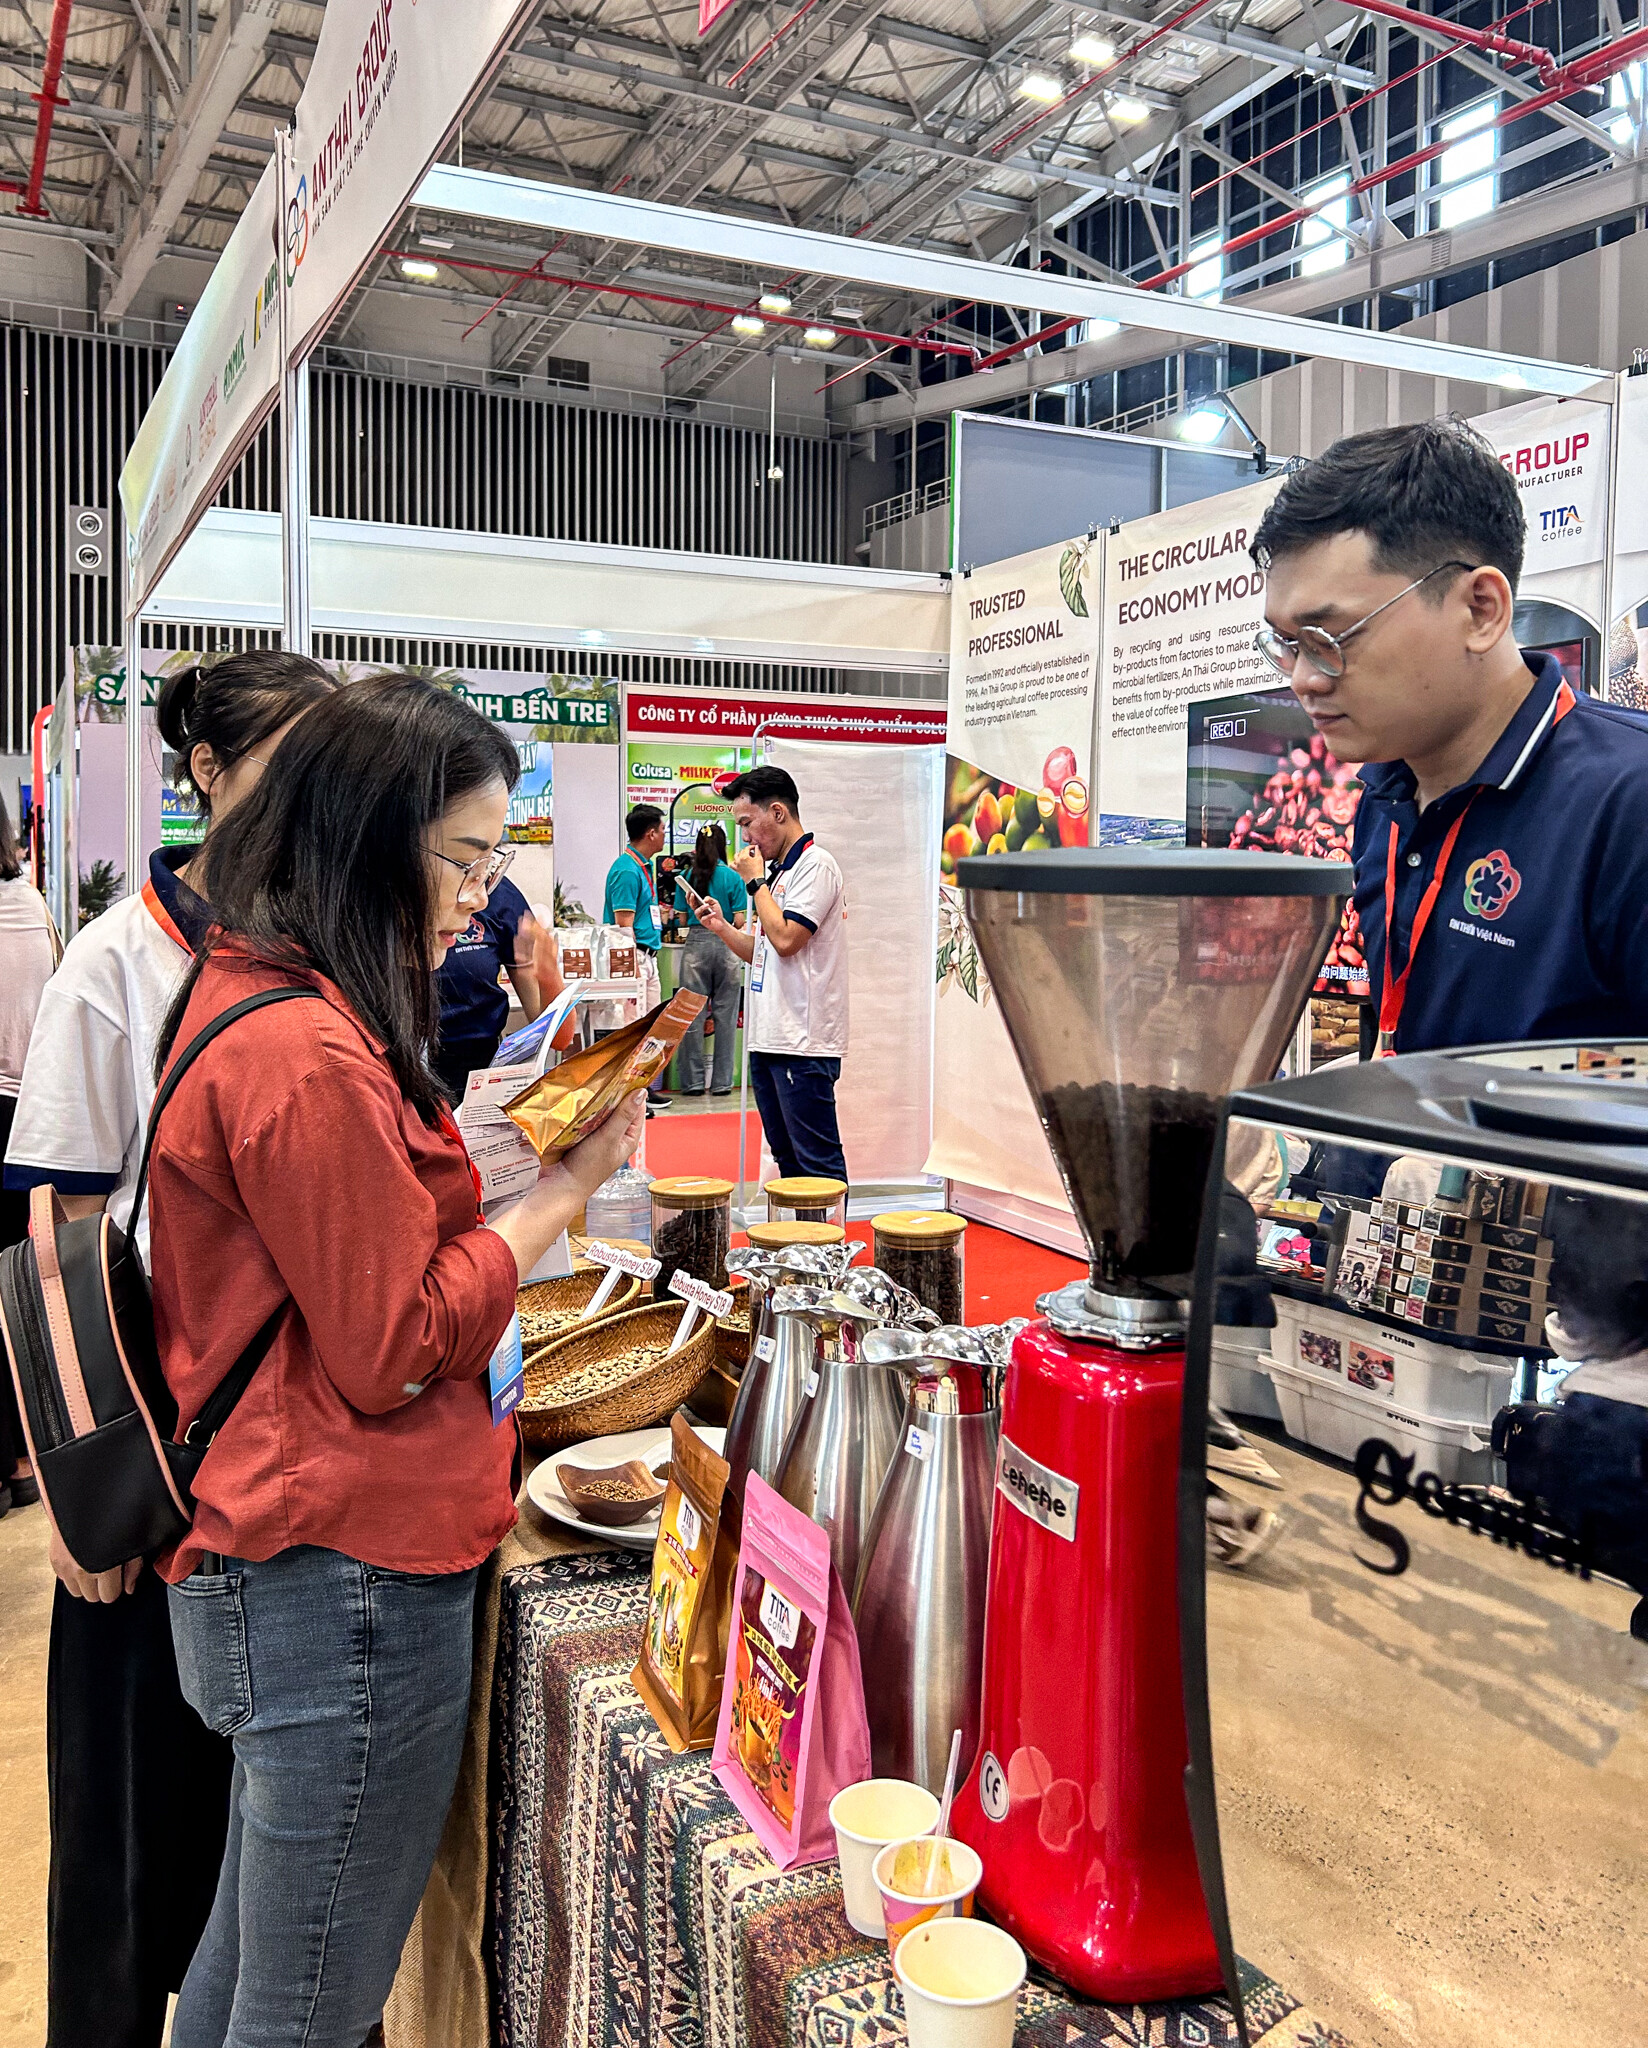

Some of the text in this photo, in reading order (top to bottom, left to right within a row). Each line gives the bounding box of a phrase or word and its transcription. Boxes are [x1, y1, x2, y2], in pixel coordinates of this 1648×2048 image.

[312, 0, 393, 211] ANTHAI GROUP
[1499, 432, 1590, 476] GROUP
[1540, 505, 1585, 531] TITA
[1541, 525, 1583, 542] coffee
[1118, 528, 1248, 581] THE CIRCULAR
[969, 588, 1026, 620] TRUSTED
[1118, 583, 1212, 624] ECONOMY
[968, 619, 1064, 657] PROFESSIONAL
[1113, 620, 1261, 659] By recycling and using resources
[986, 671, 992, 680] in
[991, 667, 1004, 679] 1992
[1004, 666, 1016, 676] and
[1016, 661, 1043, 675] officially
[1043, 653, 1083, 670] established
[1082, 652, 1090, 663] in
[1112, 674, 1146, 690] microbial
[1146, 670, 1181, 685] fertilizers,
[1181, 667, 1193, 678] An
[1210, 661, 1237, 674] Group
[1237, 656, 1264, 669] brings
[1113, 657, 1158, 675] by-products
[1159, 653, 1178, 665] from
[1179, 647, 1214, 662] factories
[1215, 645, 1225, 655] to
[1226, 639, 1250, 653] make
[1000, 681, 1018, 694] Group
[1018, 678, 1025, 689] is
[1025, 676, 1045, 690] proud
[1046, 674, 1055, 684] to
[1055, 673, 1065, 683] be
[1065, 671, 1080, 681] one
[1080, 667, 1090, 679] of
[1112, 670, 1284, 706] benefits from by-products while maximizing
[512, 690, 559, 721] BẾN
[566, 702, 608, 723] TRE
[638, 704, 676, 722] CÔNG
[678, 708, 696, 723] TY
[699, 704, 718, 725] CỔ
[721, 706, 757, 726] PHẦN
[965, 703, 975, 713] the
[1027, 691, 1049, 703] coffee
[1049, 685, 1089, 700] processing
[1112, 711, 1126, 723] the
[1126, 708, 1145, 720] value
[1145, 707, 1153, 718] of
[1153, 703, 1179, 716] coffee
[1111, 725, 1135, 739] effect
[1135, 726, 1145, 736] on
[1145, 723, 1157, 734] the
[1213, 722, 1231, 738] REC
[632, 763, 672, 778] Colusa
[1493, 933, 1516, 948] Nam
[1318, 965, 1369, 982] 的问题始终
[589, 1244, 656, 1276] Robusta Honey S16
[670, 1273, 728, 1313] Robusta Honey S18
[769, 1592, 791, 1630] TITA
[767, 1617, 790, 1642] coffee
